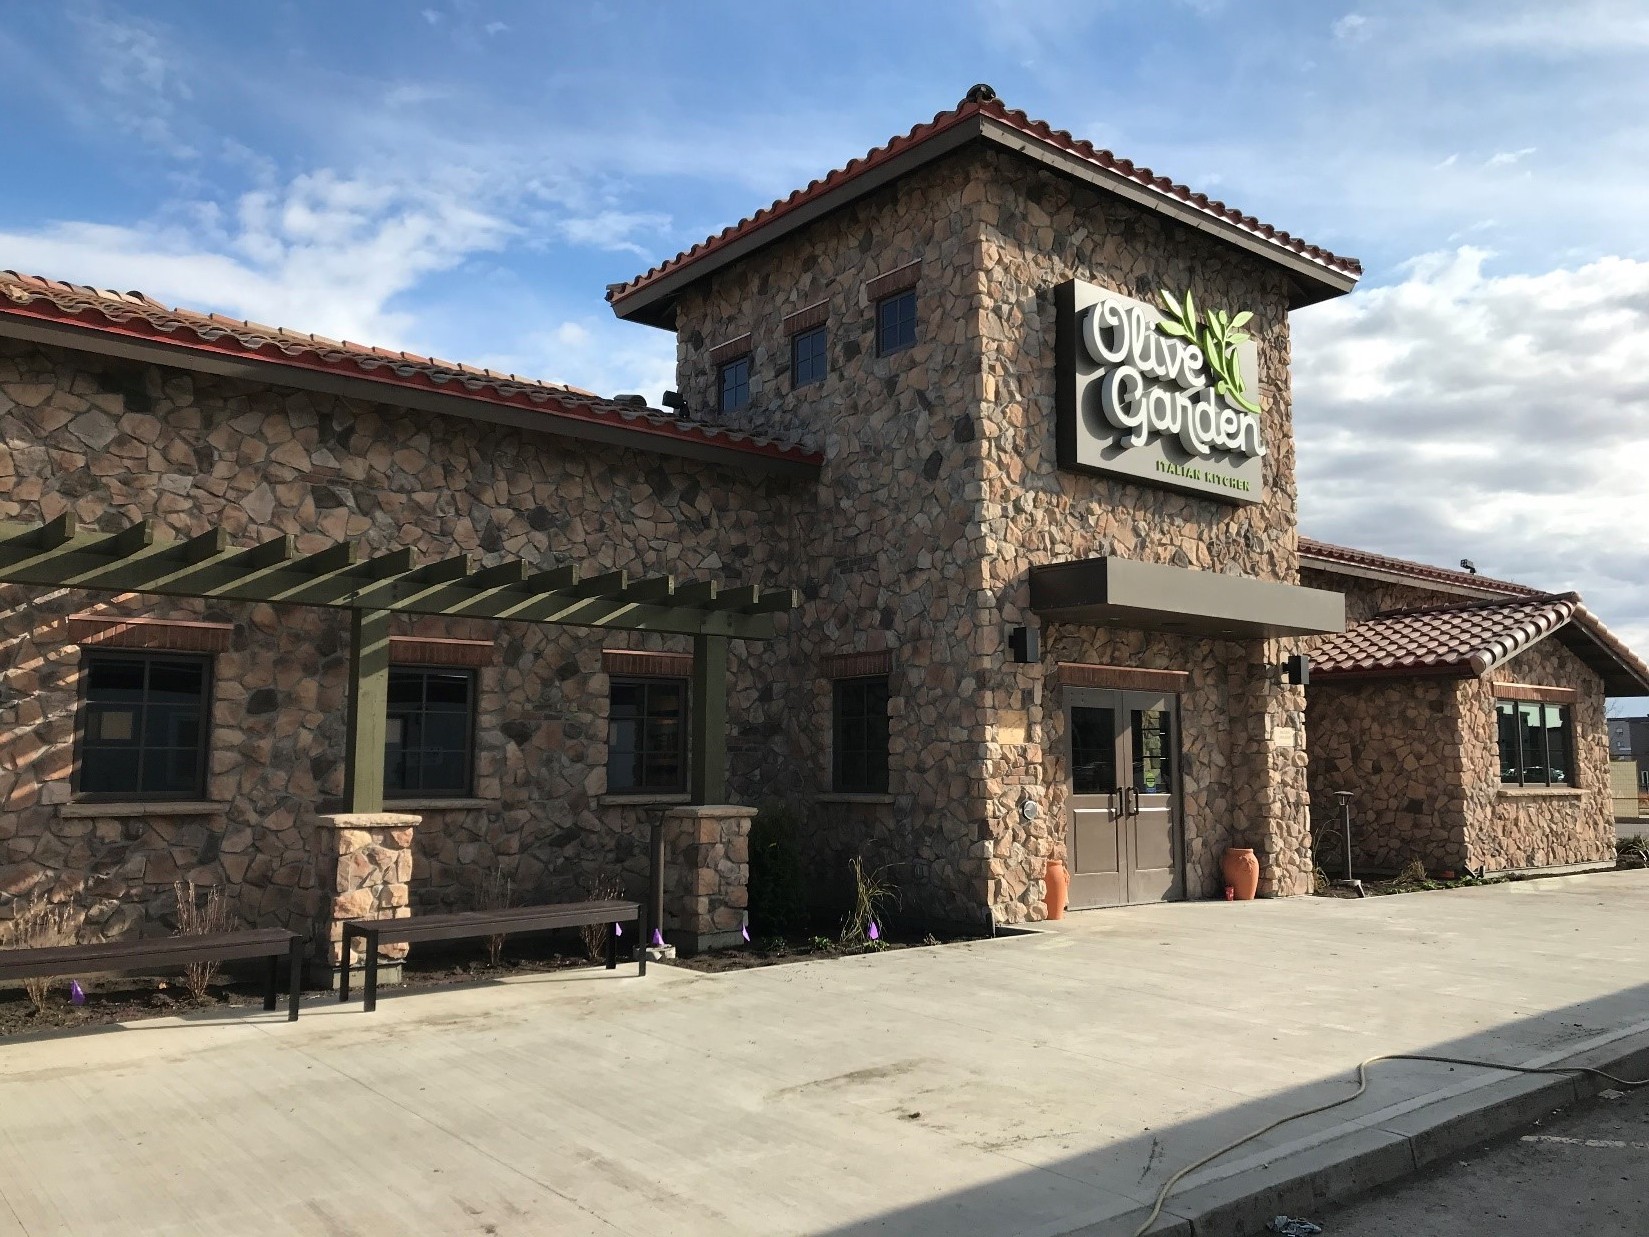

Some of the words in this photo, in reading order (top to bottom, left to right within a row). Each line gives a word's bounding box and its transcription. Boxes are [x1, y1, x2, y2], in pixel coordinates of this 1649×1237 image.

[1090, 299, 1206, 387] Olive
[1110, 365, 1267, 456] Garden
[1156, 460, 1201, 481] ITALIAN
[1205, 471, 1250, 492] KITCHEN
